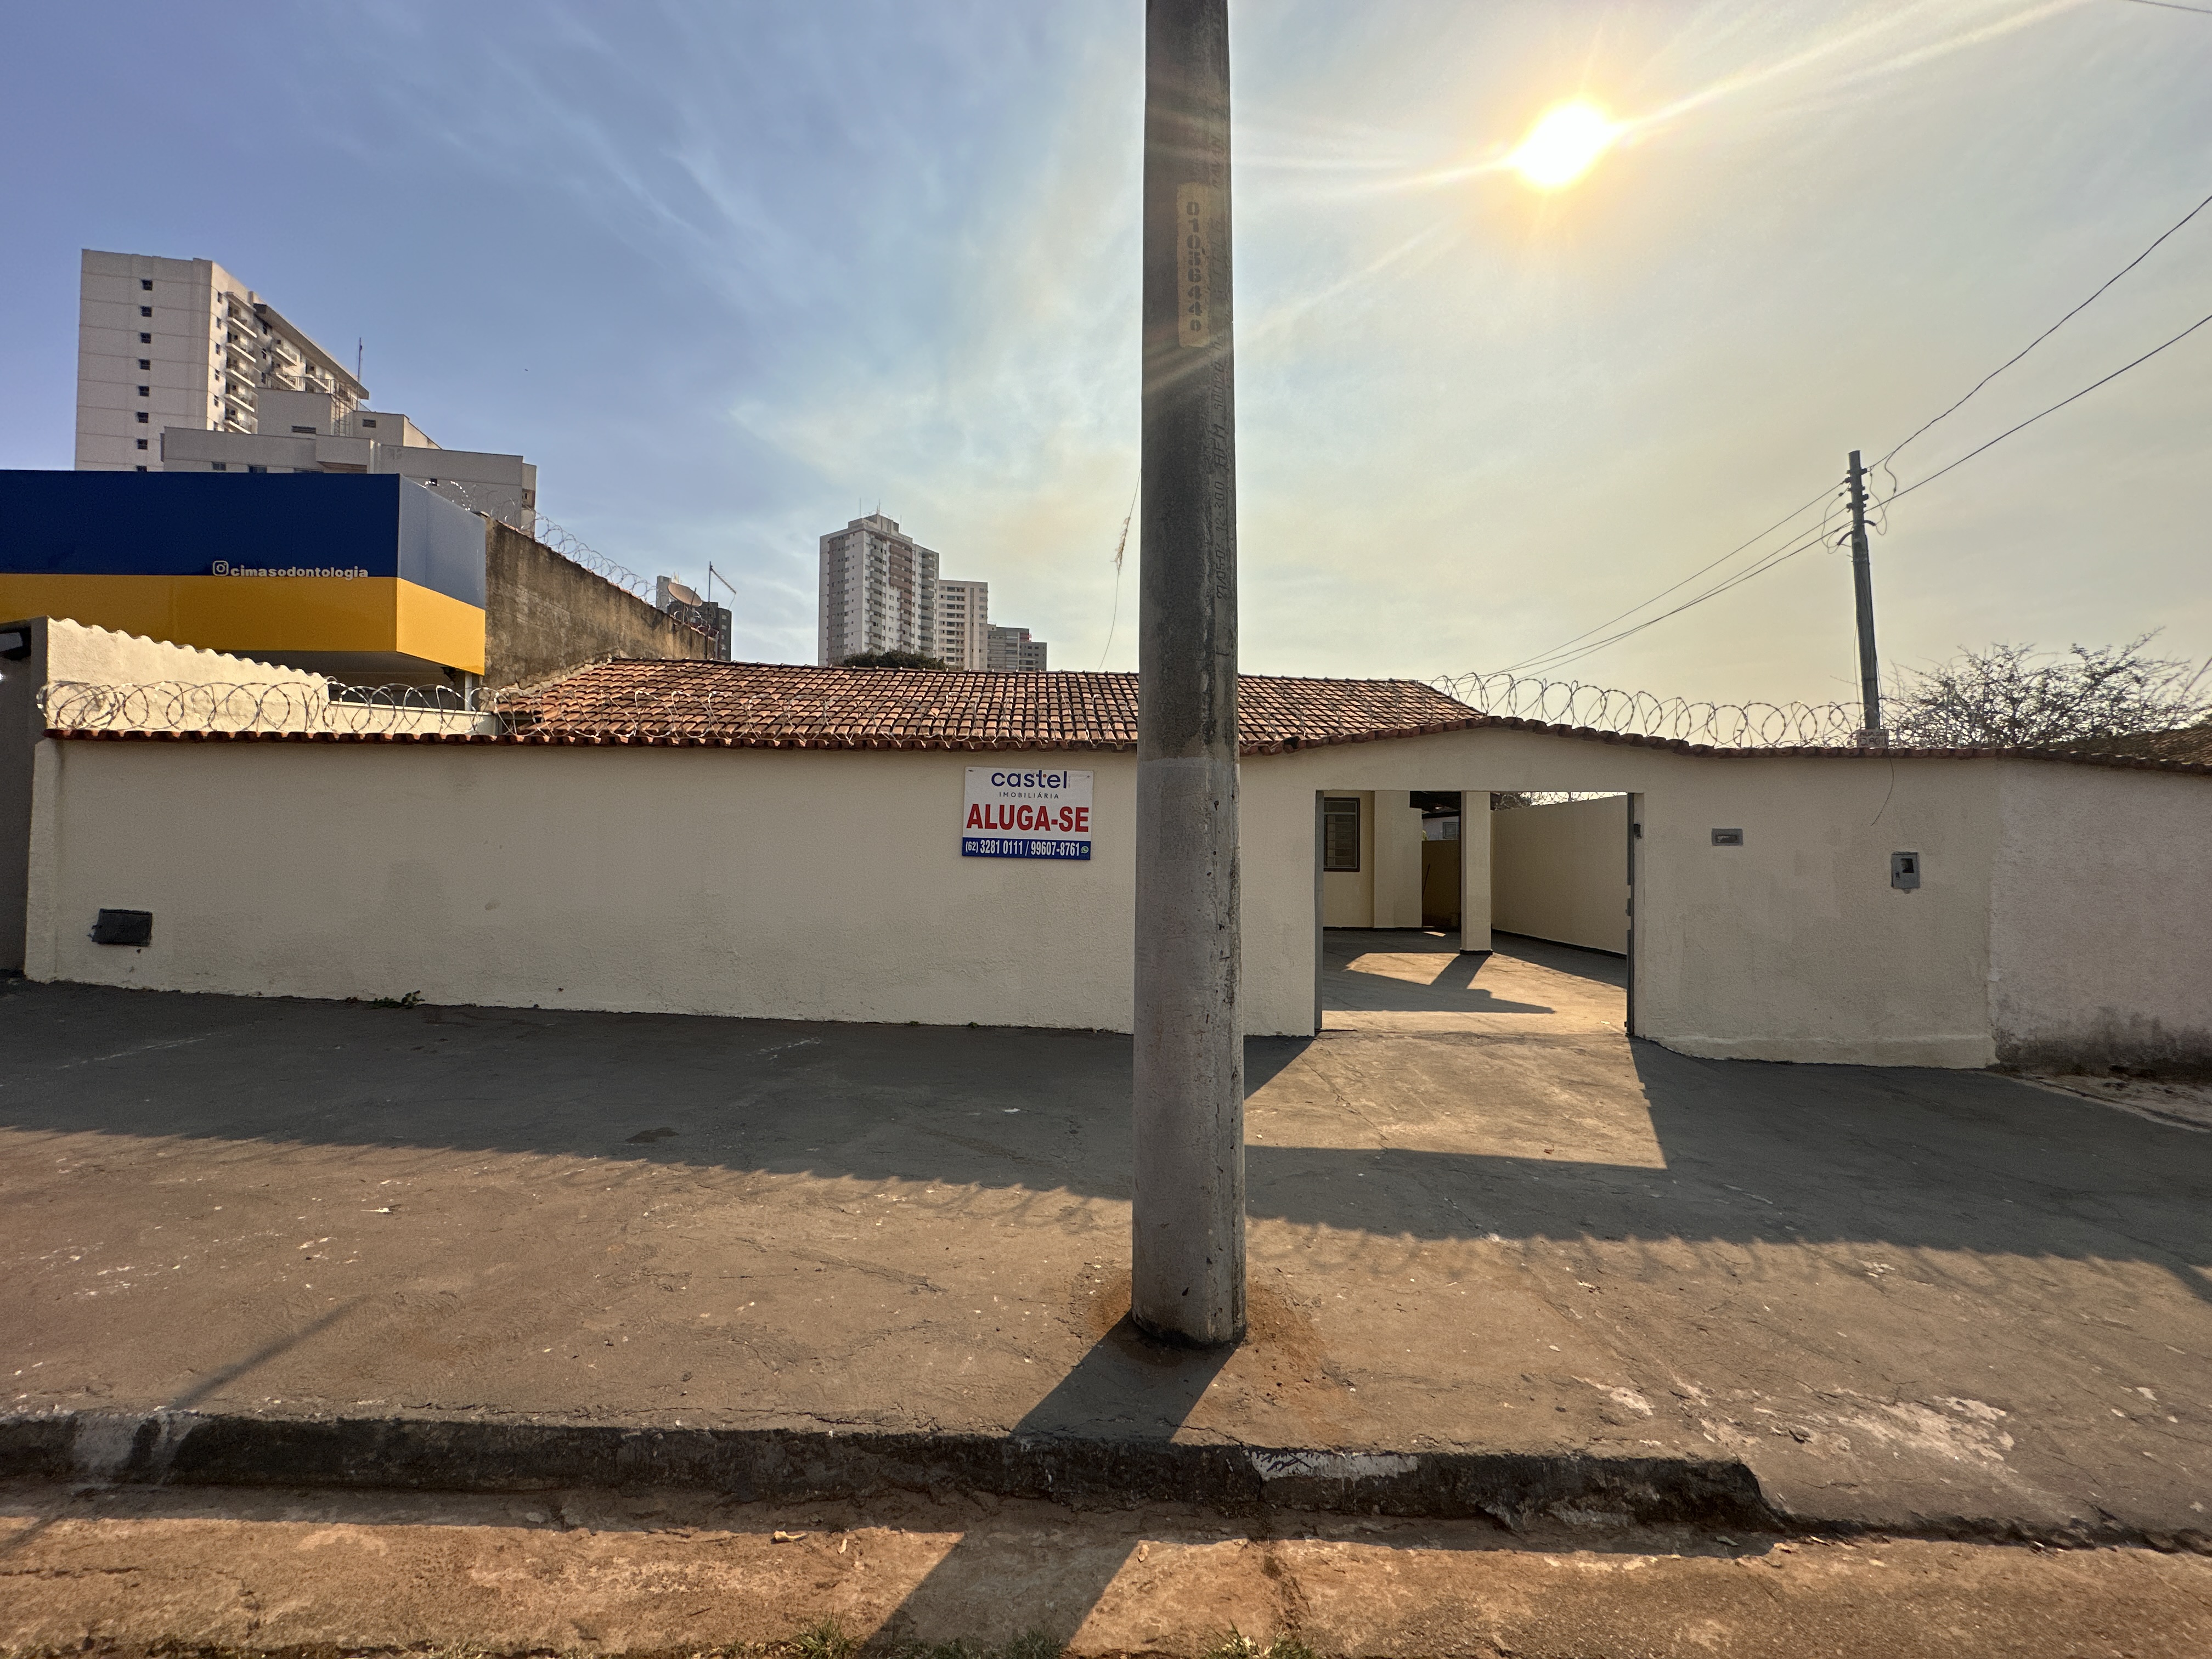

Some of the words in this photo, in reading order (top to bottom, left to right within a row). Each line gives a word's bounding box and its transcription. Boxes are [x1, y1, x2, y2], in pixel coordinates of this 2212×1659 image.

[230, 565, 368, 580] cimasodontologia
[991, 770, 1067, 788] castel
[967, 804, 1088, 832] ALUGA-SE
[966, 841, 978, 853] (62)
[980, 839, 1000, 854] 3281
[1003, 840, 1022, 855] 0111
[1031, 841, 1079, 856] 99607-8761
